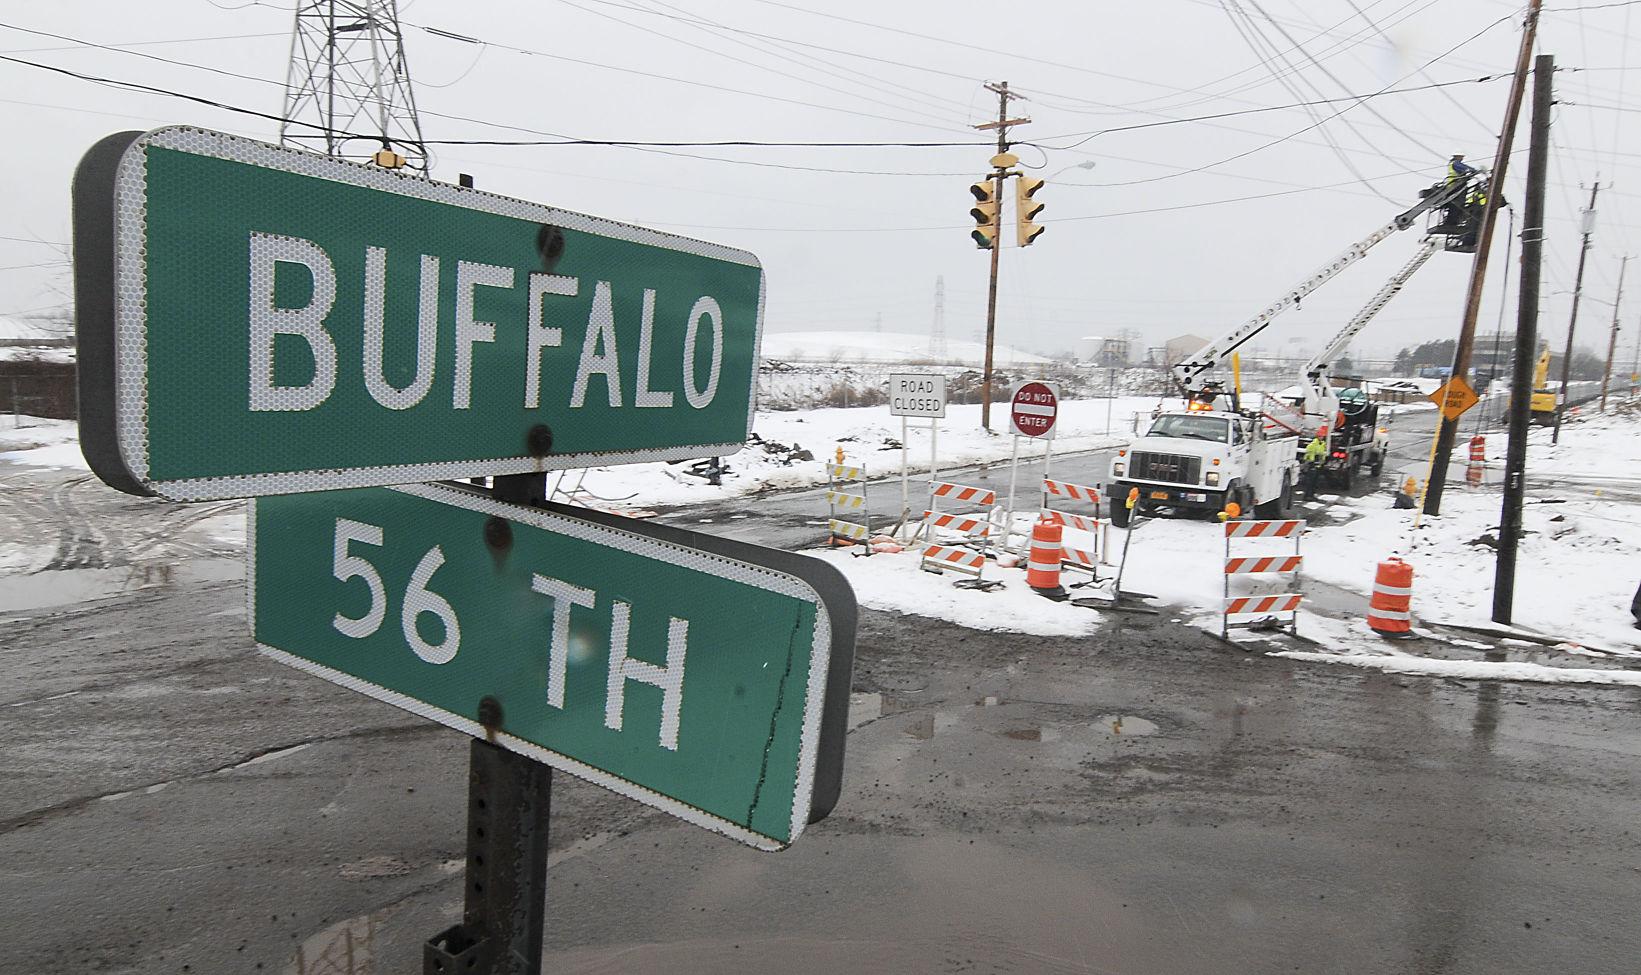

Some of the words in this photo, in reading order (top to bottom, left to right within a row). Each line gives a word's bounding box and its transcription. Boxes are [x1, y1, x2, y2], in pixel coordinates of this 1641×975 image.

[249, 230, 724, 411] BUFFALO
[901, 380, 934, 394] ROAD
[1018, 391, 1032, 402] DO
[1034, 393, 1052, 403] NOT
[1445, 390, 1465, 399] OUGH
[894, 397, 941, 412] CLOSED
[1019, 416, 1048, 428] ENTER
[333, 517, 462, 665] 56
[531, 572, 690, 752] TH
